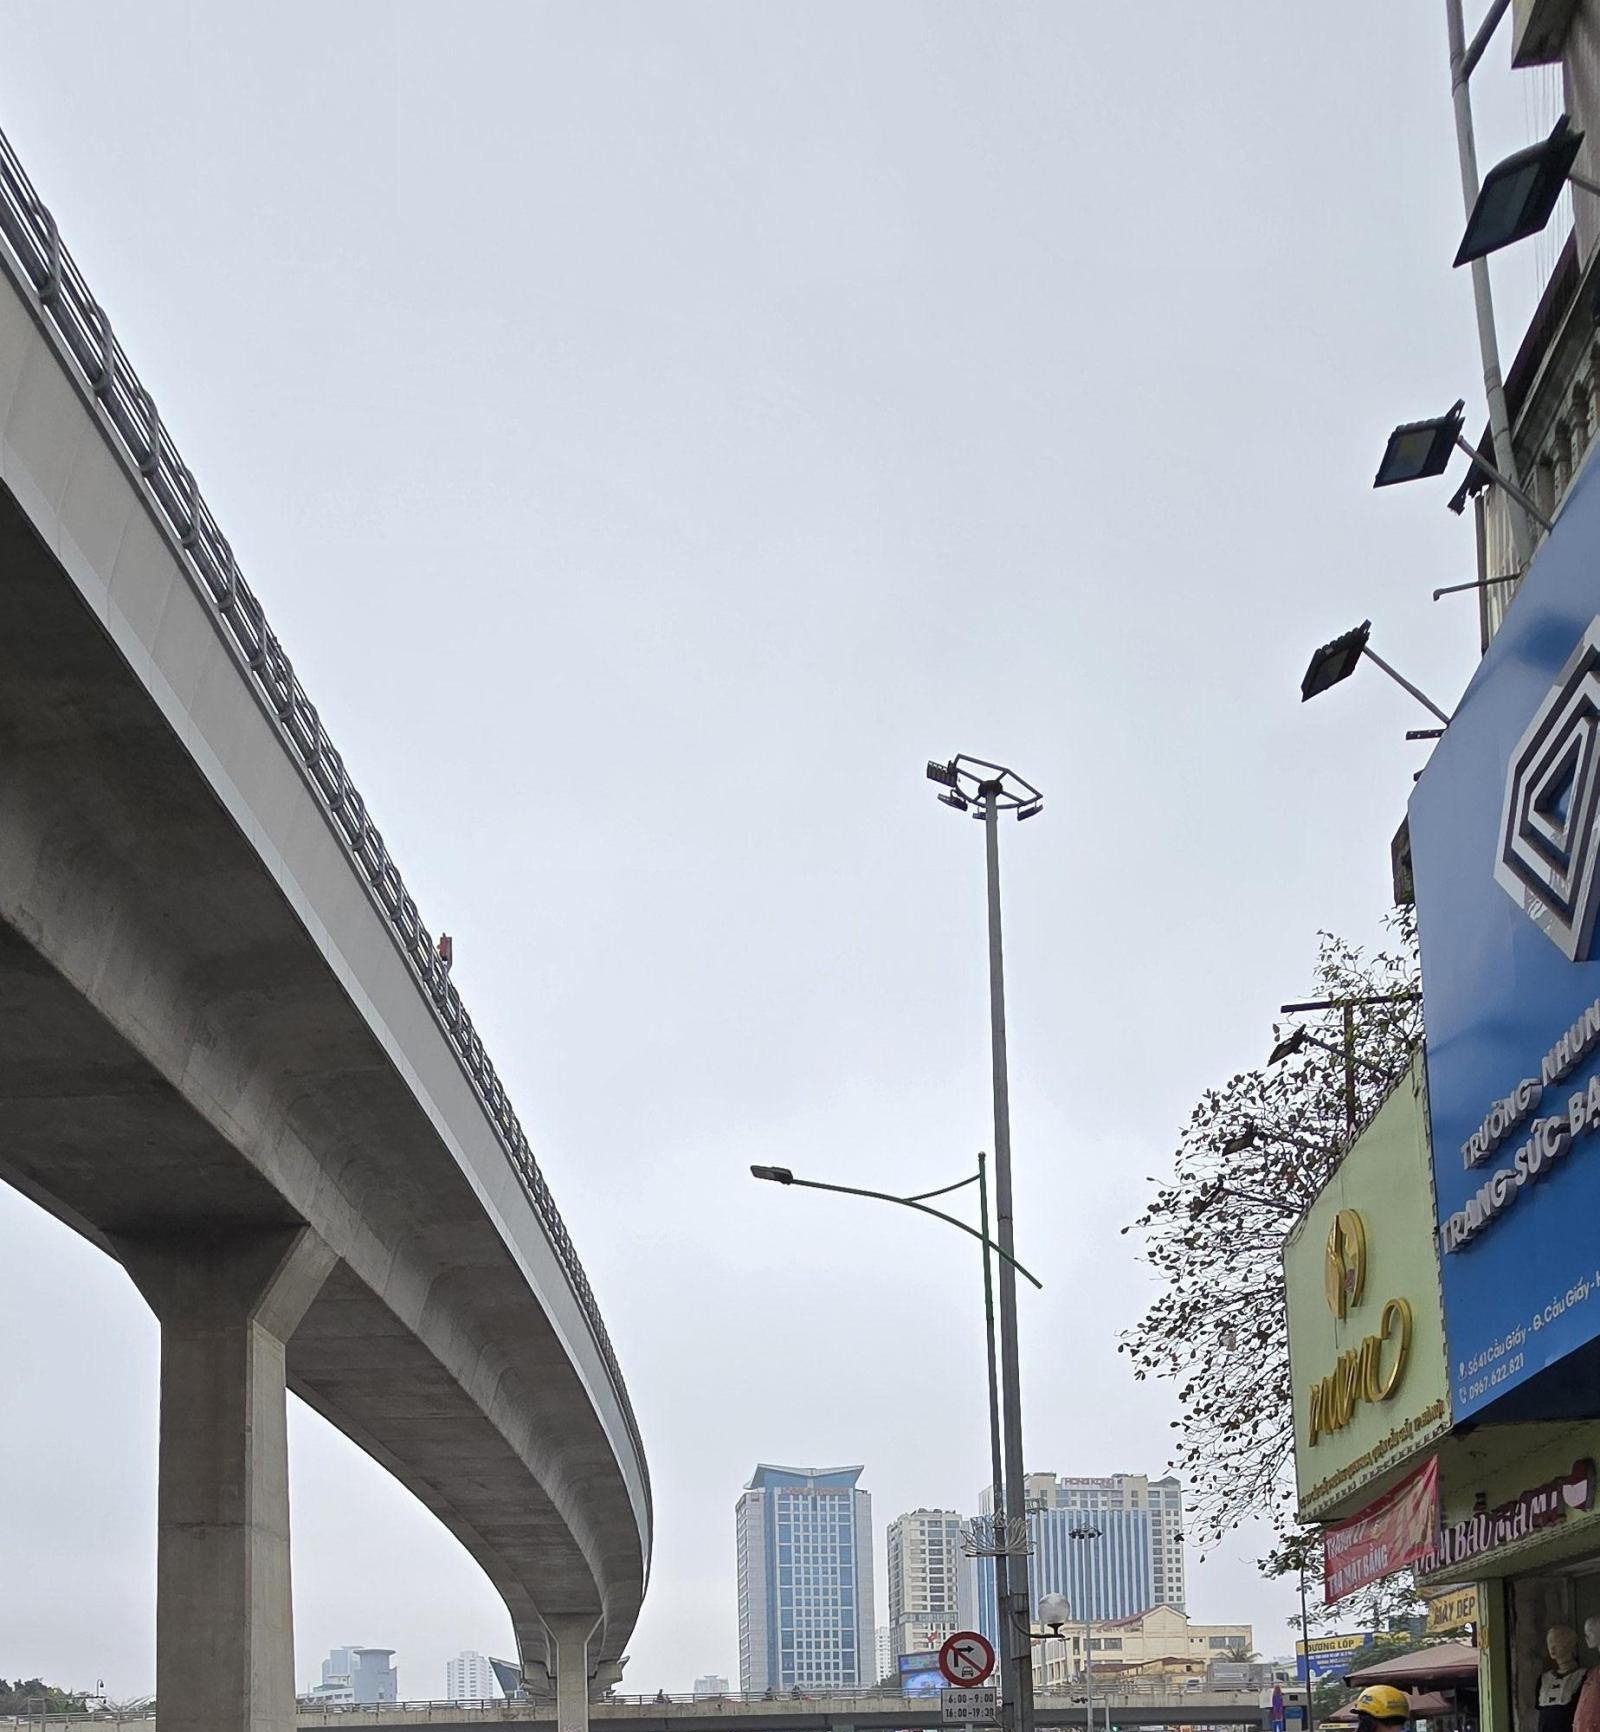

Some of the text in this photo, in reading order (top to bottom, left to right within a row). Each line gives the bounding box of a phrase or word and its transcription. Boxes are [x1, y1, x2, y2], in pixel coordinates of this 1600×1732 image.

[1461, 1077, 1538, 1170] TRƯỜNG
[1440, 1168, 1515, 1255] TRANG
[1514, 1114, 1568, 1186] SỨC
